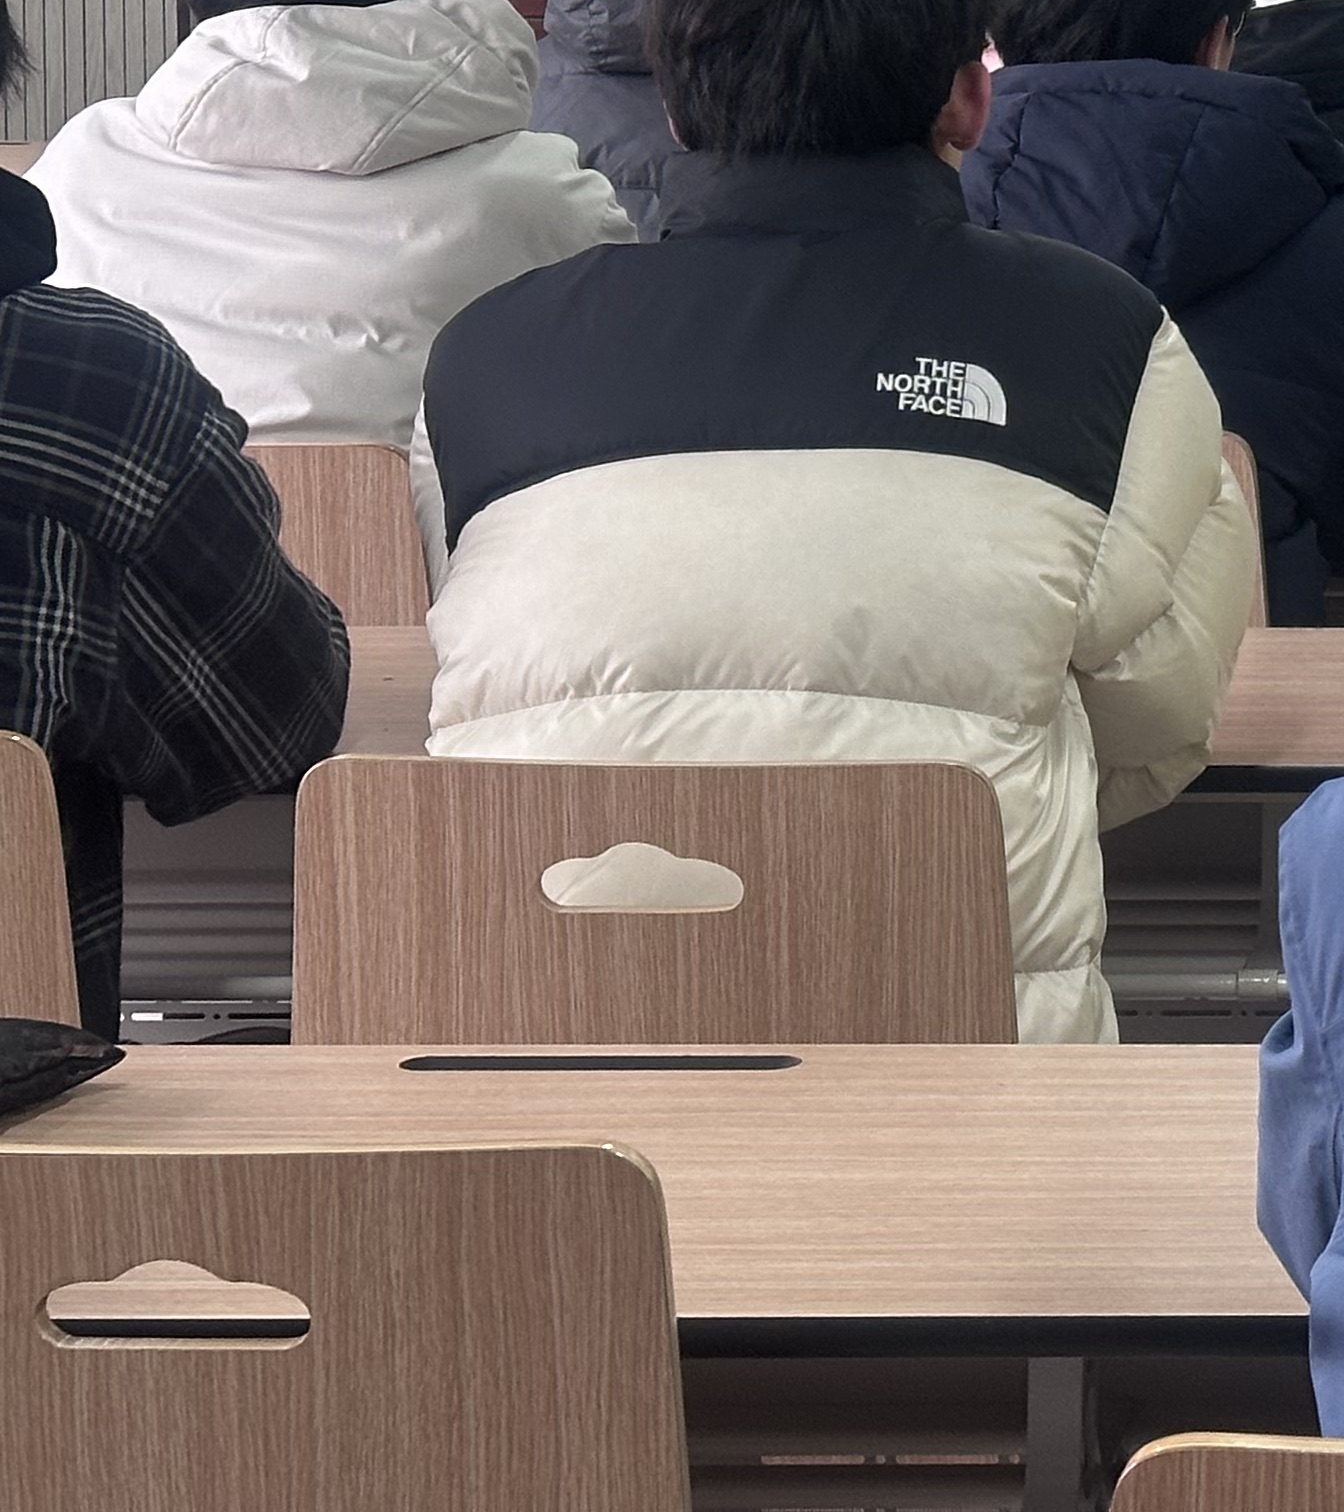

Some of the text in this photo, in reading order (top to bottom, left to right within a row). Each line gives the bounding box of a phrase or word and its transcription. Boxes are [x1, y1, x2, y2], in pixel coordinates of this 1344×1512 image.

[915, 357, 966, 380] THE
[876, 373, 965, 399] NORTH
[898, 393, 962, 418] FACE
